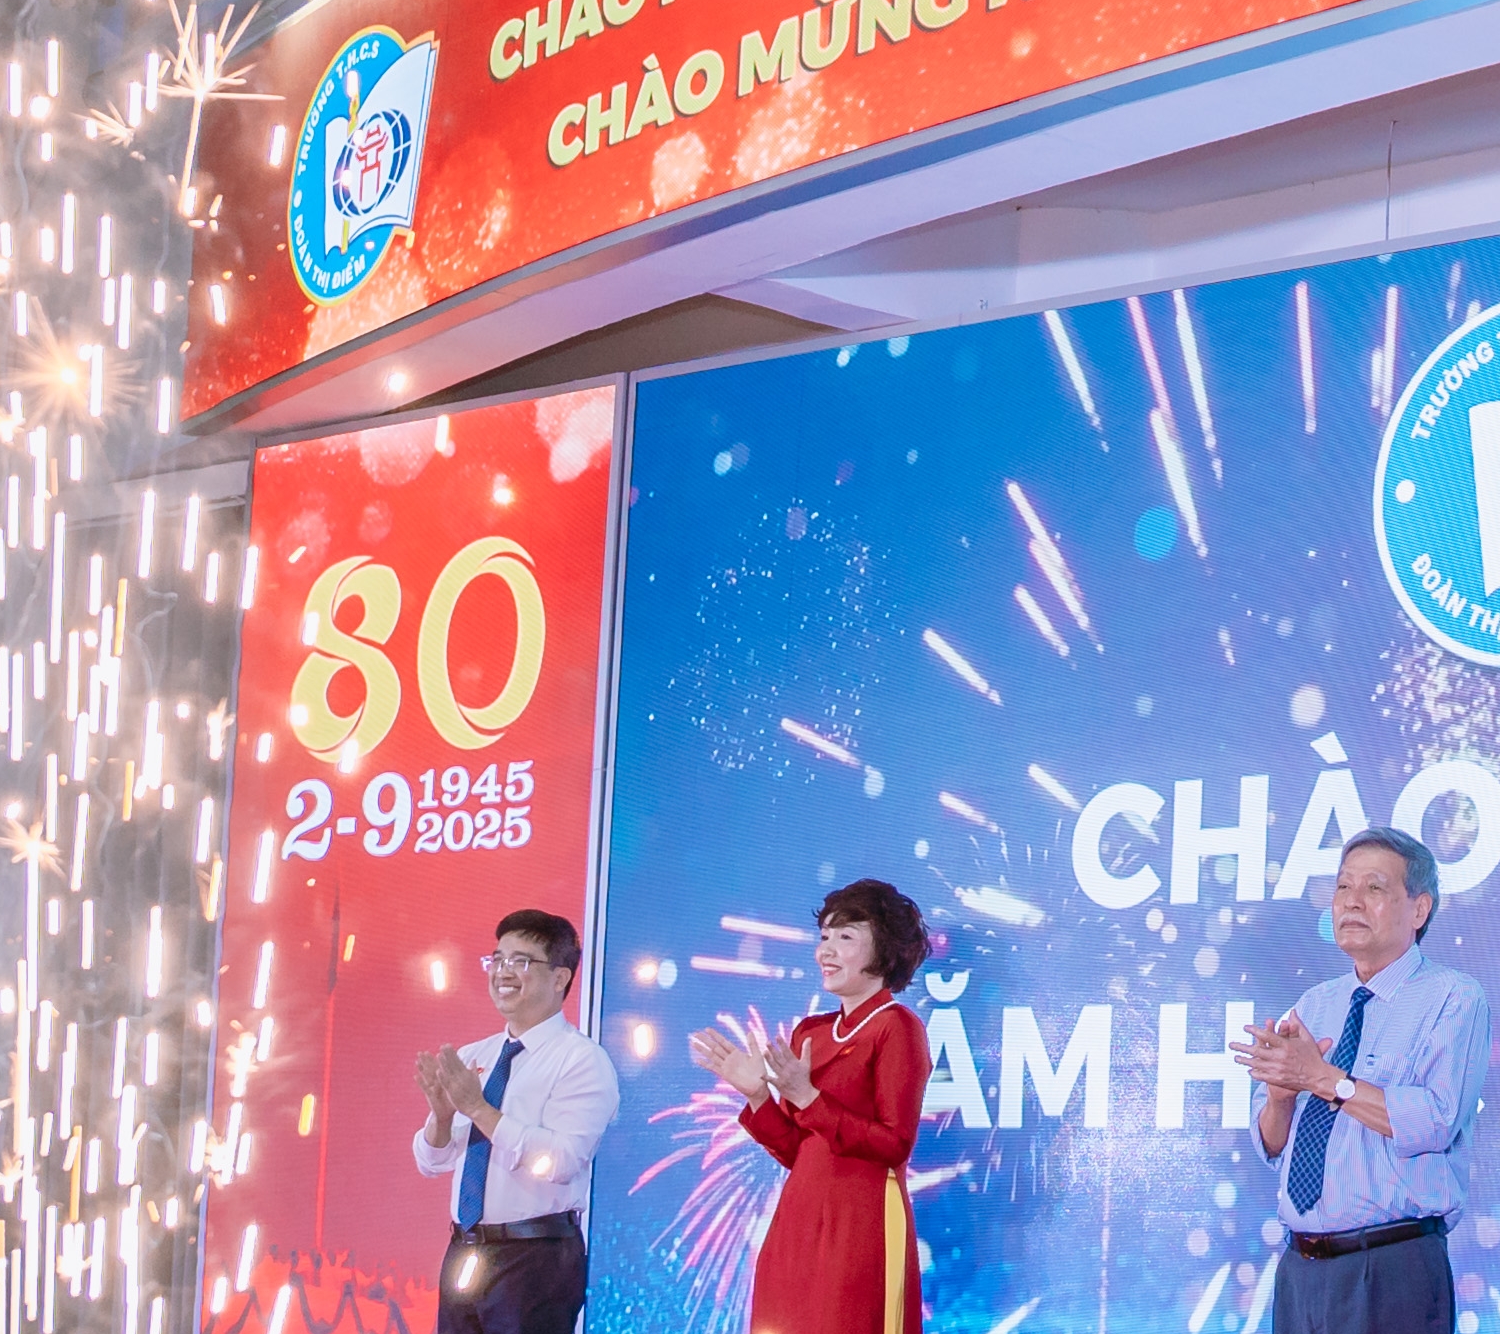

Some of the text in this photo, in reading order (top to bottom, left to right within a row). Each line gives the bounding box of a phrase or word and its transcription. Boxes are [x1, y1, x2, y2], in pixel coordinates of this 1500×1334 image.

[297, 39, 381, 176] TRƯỜNG T.H.C.S
[546, 49, 726, 168] CHÀO
[293, 213, 313, 274] ĐOÀN
[312, 264, 331, 294] THỊ
[1410, 341, 1496, 441] TRƯỜNG
[1410, 552, 1467, 619] ĐOÀN
[290, 535, 547, 765] 80
[281, 771, 414, 861] 2-9
[414, 805, 533, 854] 2025
[417, 758, 535, 810] 1945
[921, 970, 1113, 1129] ĂM
